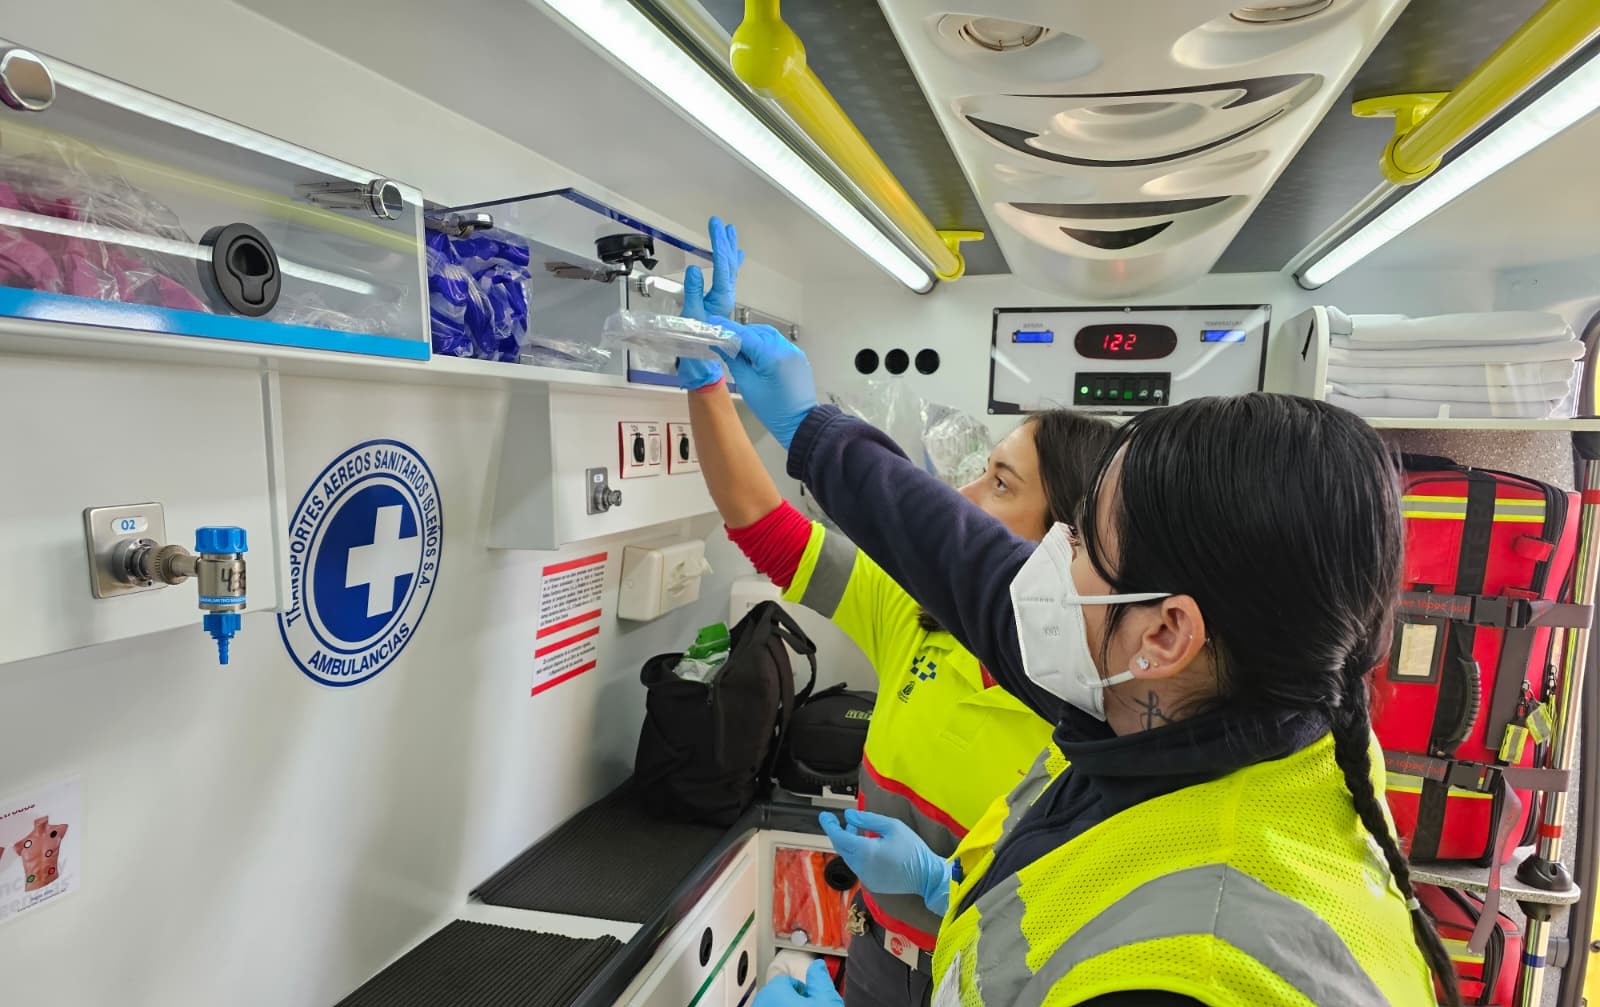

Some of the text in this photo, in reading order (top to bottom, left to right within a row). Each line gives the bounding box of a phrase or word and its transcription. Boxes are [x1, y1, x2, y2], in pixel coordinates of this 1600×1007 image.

[1103, 333, 1137, 352] 122
[323, 452, 371, 502] AEREOS
[374, 450, 429, 497] SANITARIOS
[422, 492, 440, 558] ISLEÑOS
[307, 623, 410, 677] AMBULANCIAS
